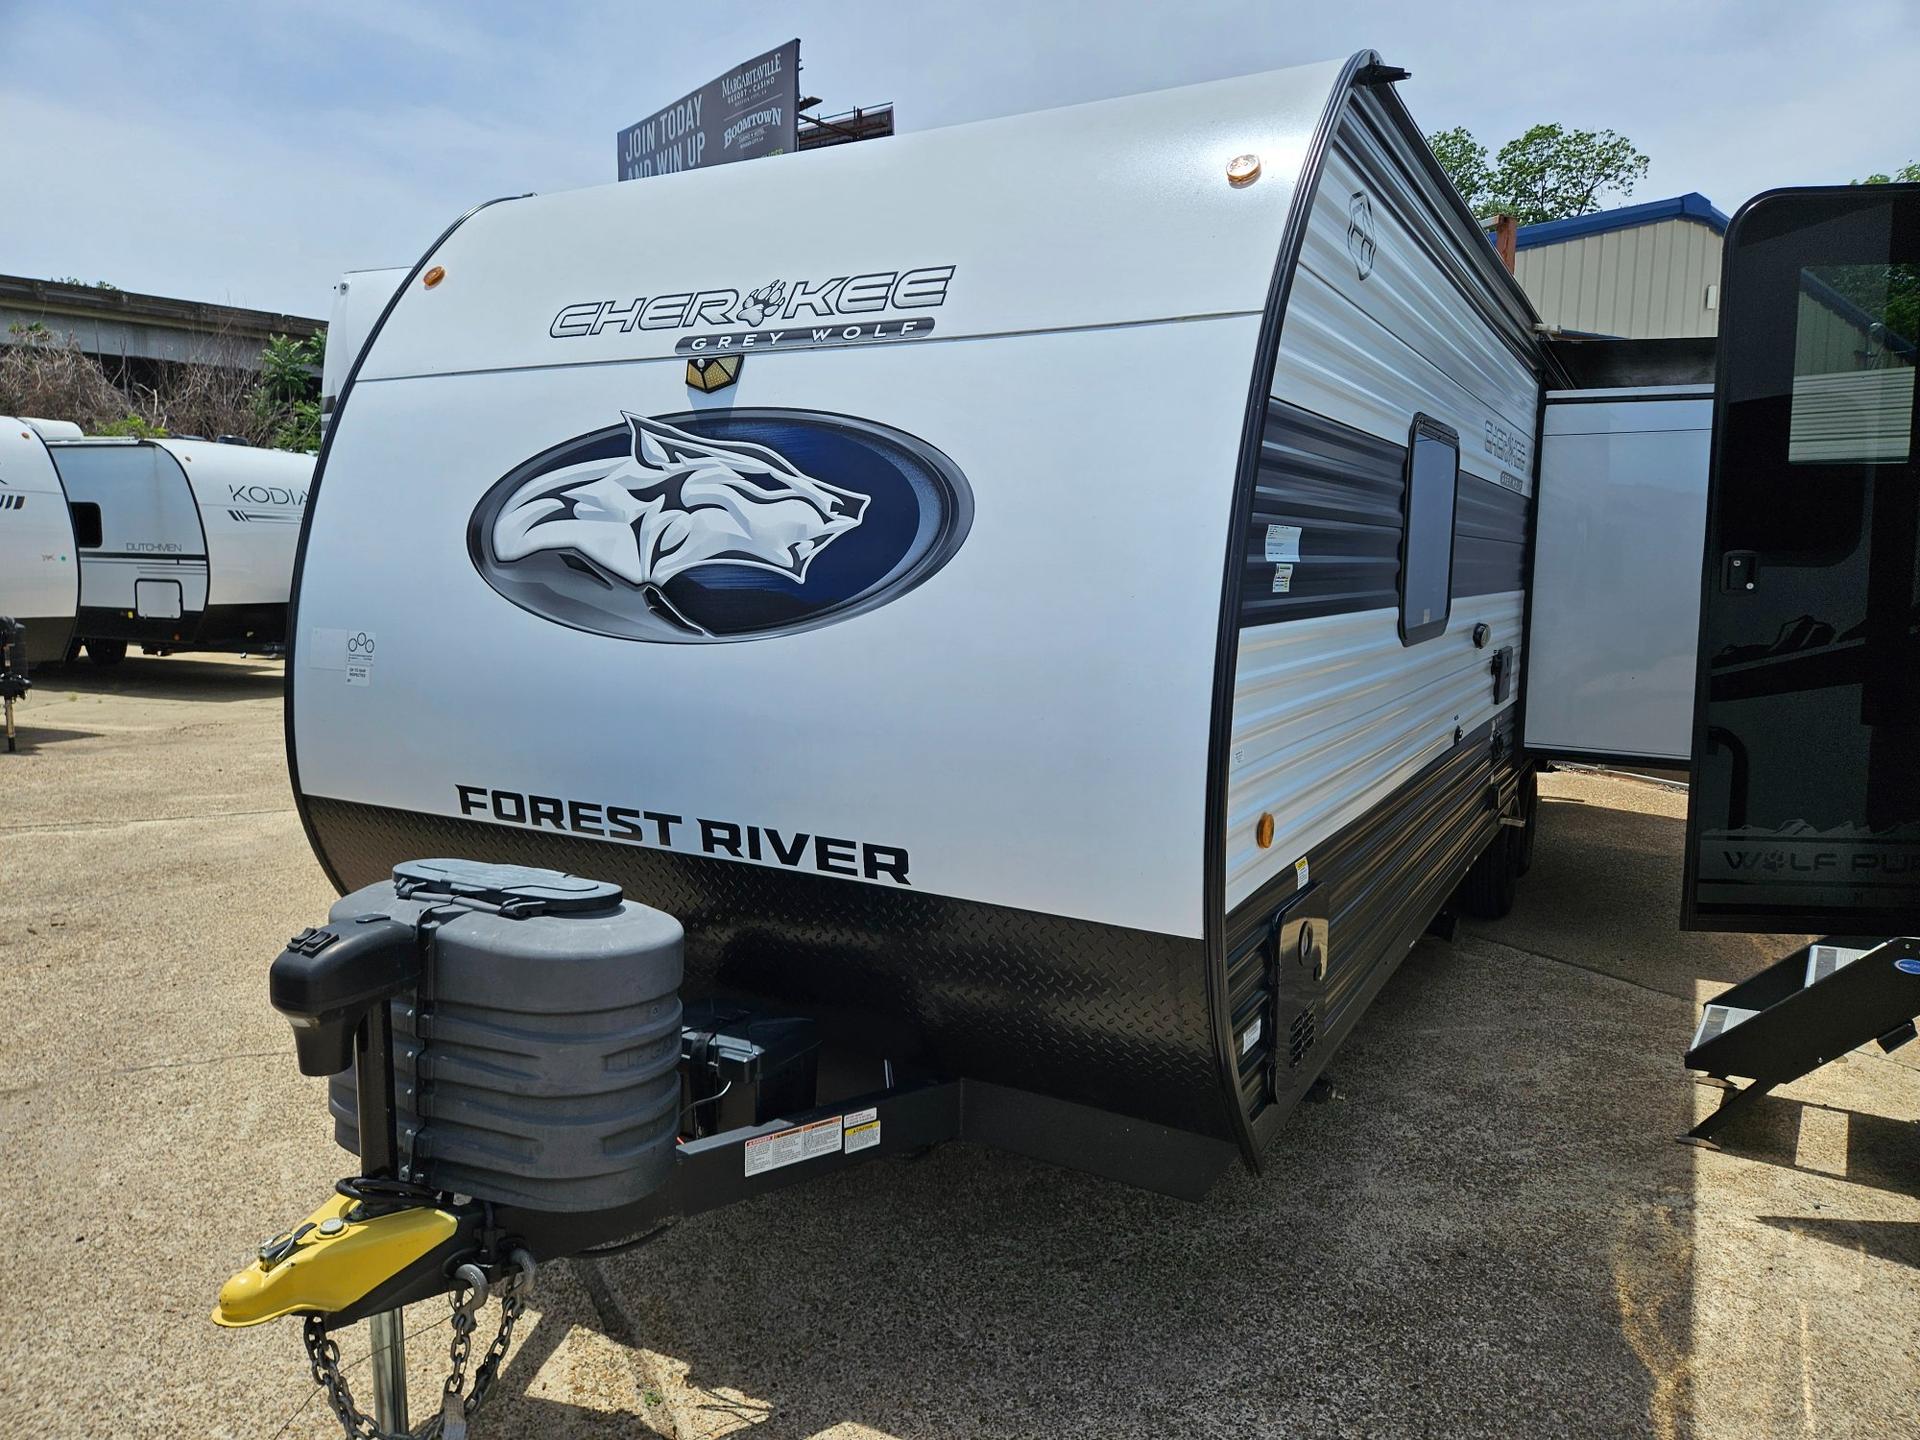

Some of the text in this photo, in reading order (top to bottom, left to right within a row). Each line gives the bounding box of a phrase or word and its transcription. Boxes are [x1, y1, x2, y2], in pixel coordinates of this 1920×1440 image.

[721, 52, 782, 98] MARGARITAVILLE
[752, 76, 775, 93] CASINO
[625, 94, 702, 162] JOIN TODAY
[723, 107, 782, 150] BOOMTOWN
[656, 142, 682, 175] WIN
[687, 131, 706, 168] UP
[691, 321, 920, 352] GREY WOLF
[126, 542, 182, 552] DUTCHMEN
[454, 784, 912, 886] FOREST RIVER
